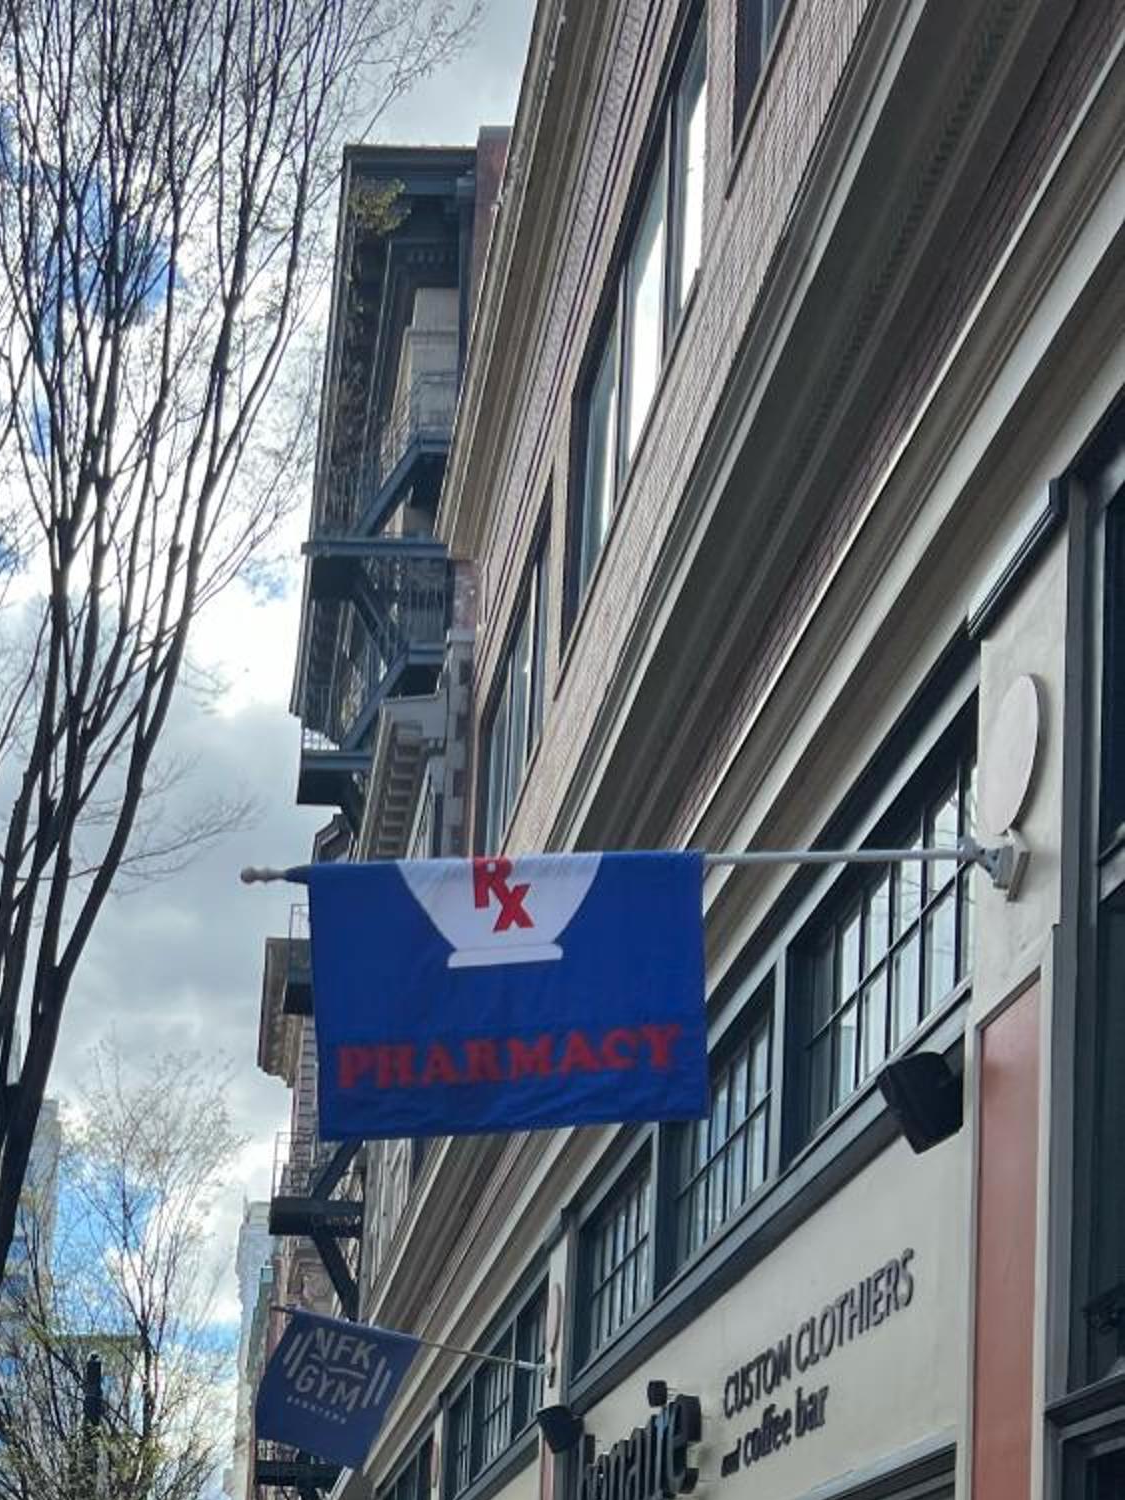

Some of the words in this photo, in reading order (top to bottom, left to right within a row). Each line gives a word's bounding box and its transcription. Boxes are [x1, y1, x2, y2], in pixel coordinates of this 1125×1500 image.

[336, 1023, 683, 1090] PHARMACY
[723, 1332, 793, 1420] CUSTOM
[794, 1247, 915, 1374] CLOTHIERS
[295, 1363, 362, 1413] GYM
[742, 1403, 792, 1468] coffee
[794, 1385, 829, 1438] bar
